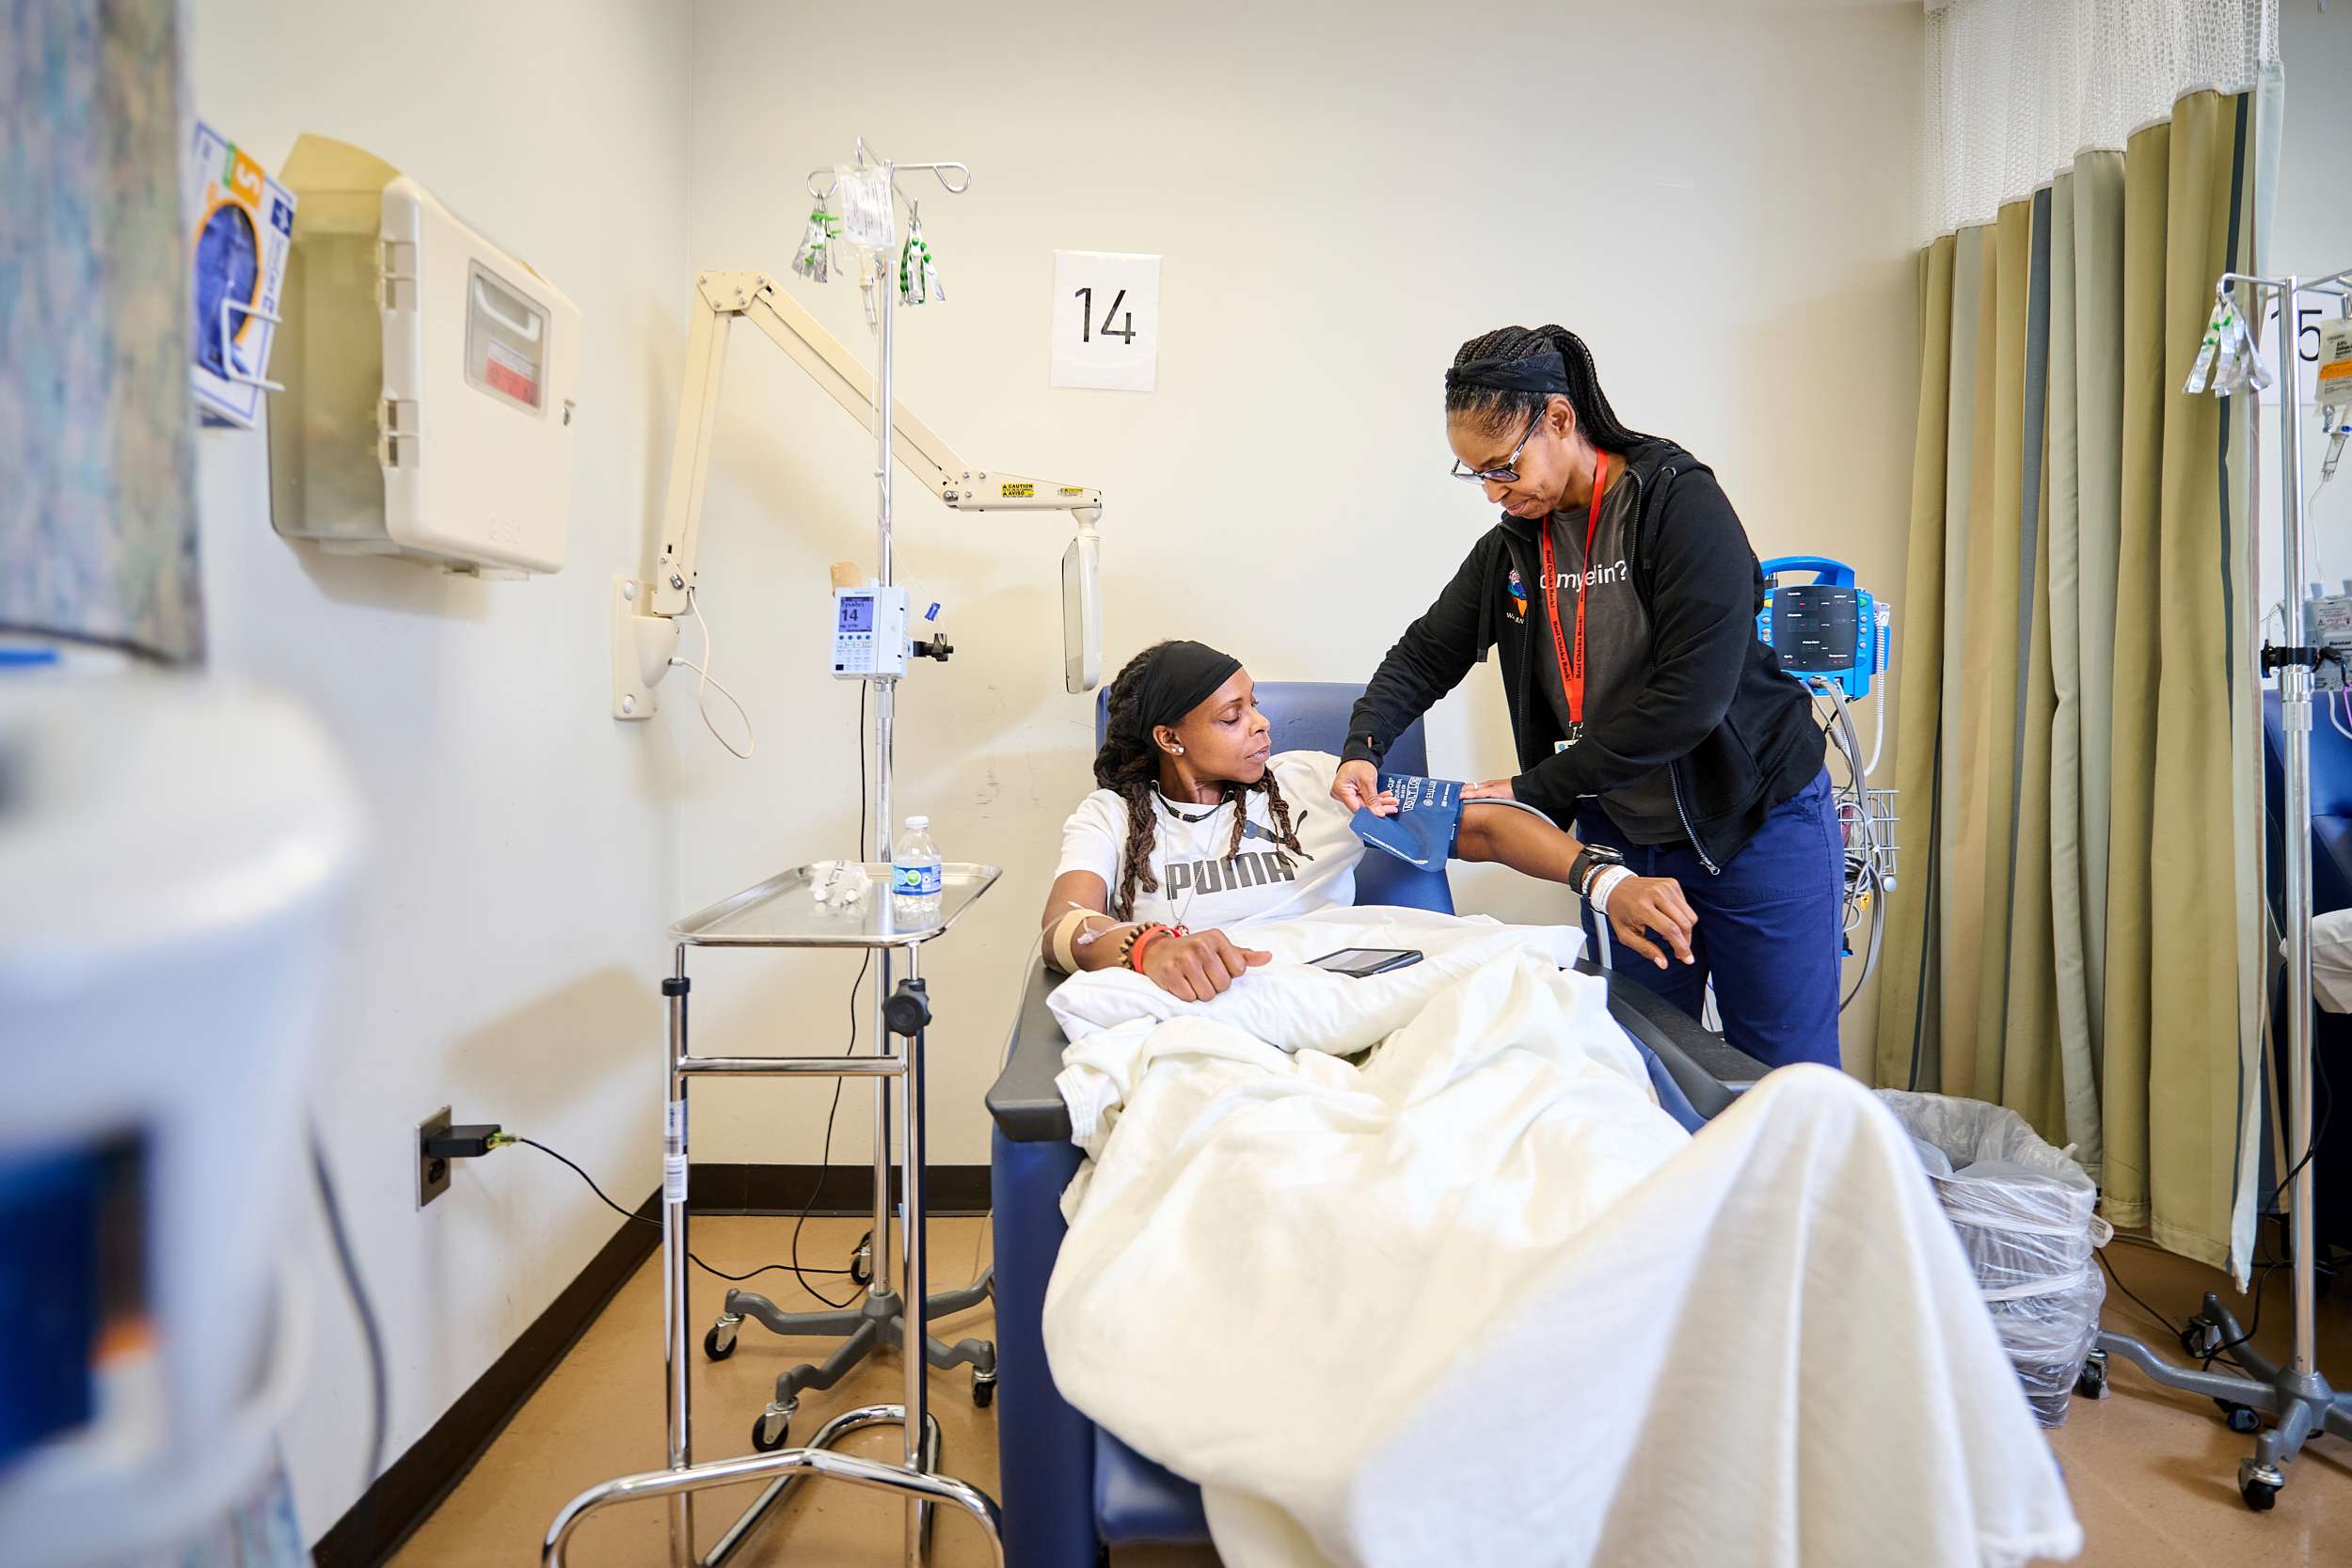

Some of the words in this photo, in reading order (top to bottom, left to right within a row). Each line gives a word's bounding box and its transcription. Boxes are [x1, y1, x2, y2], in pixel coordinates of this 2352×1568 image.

[236, 161, 261, 195] S
[1074, 287, 1136, 344] 14
[2270, 309, 2323, 362] 5
[1556, 560, 1627, 593] myelin?
[842, 609, 858, 622] 14
[1165, 851, 1295, 900] PUMA
